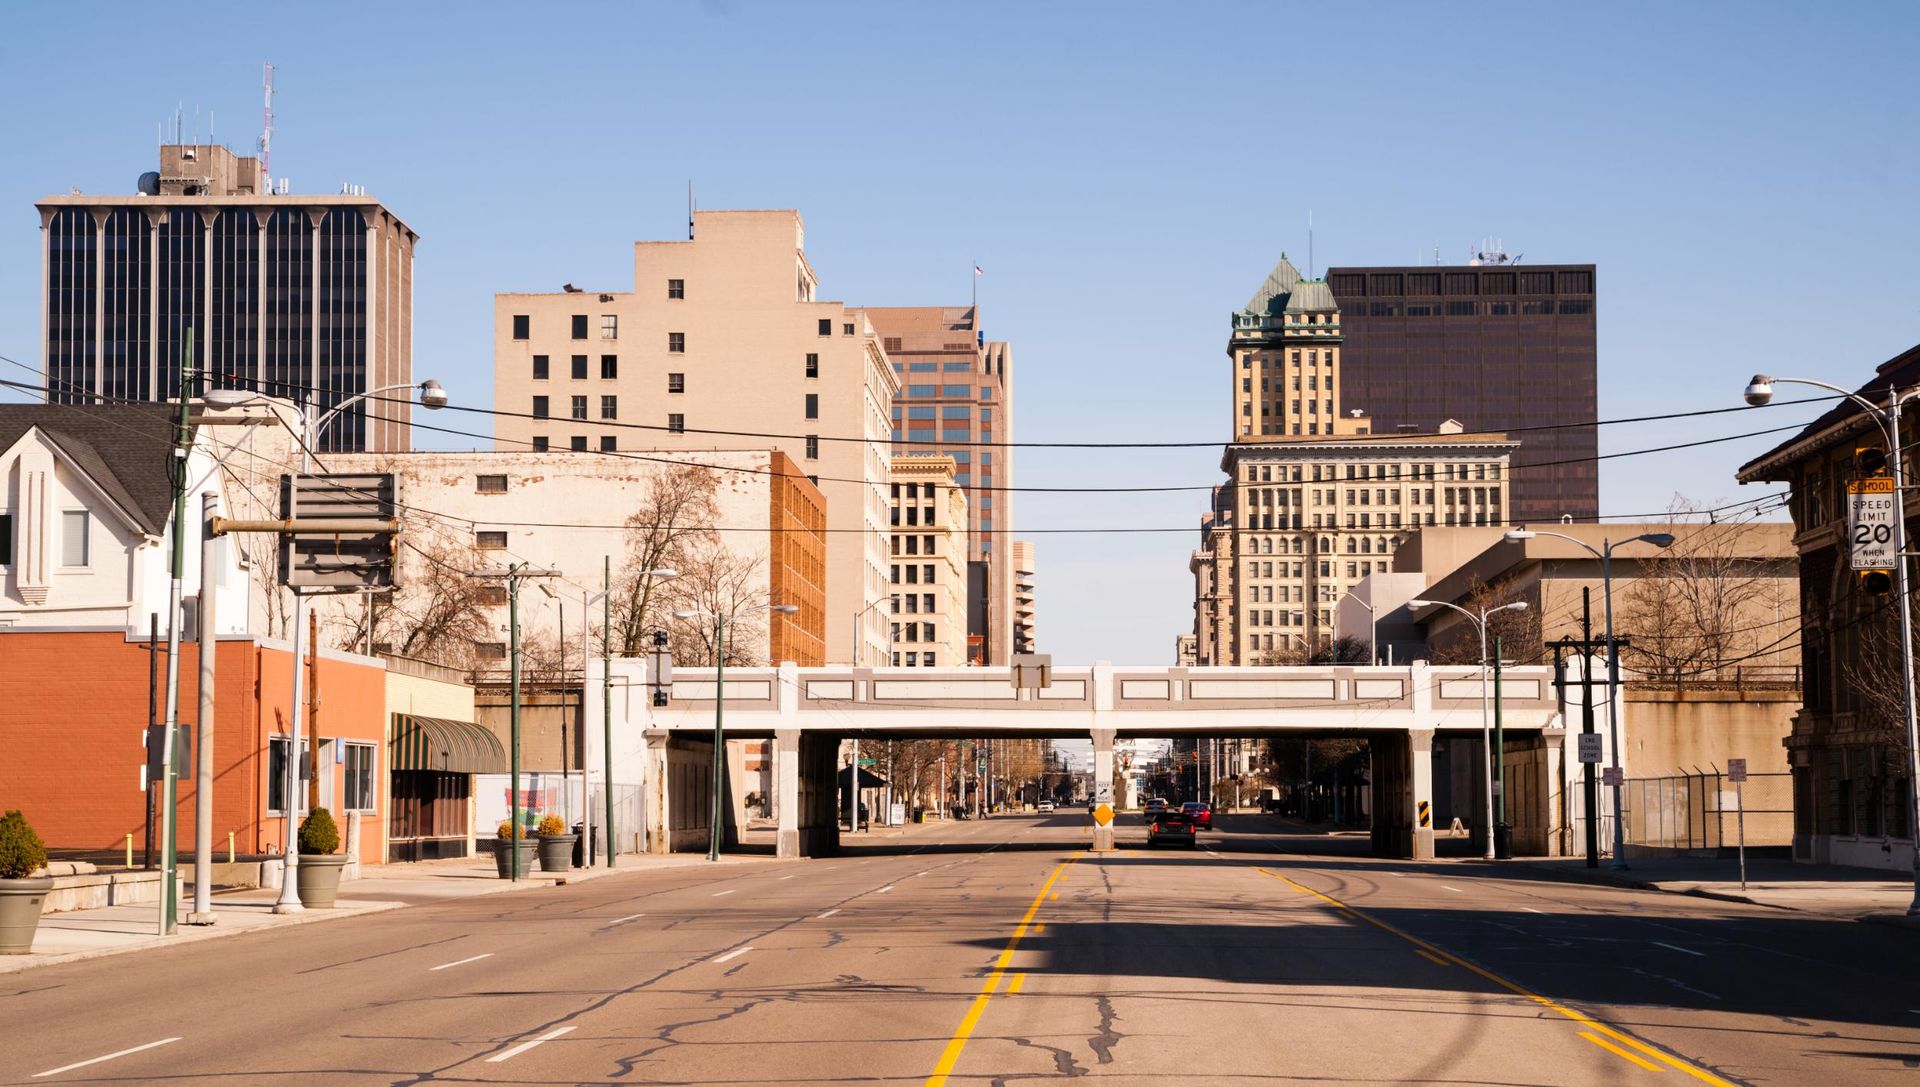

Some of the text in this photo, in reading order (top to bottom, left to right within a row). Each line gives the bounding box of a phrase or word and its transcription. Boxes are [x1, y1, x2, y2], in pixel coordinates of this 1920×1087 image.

[1851, 482, 1891, 490] SCHOOL
[1852, 500, 1891, 510] SPEED
[1857, 512, 1887, 522] LIMIT
[1854, 524, 1891, 544] 20
[1862, 549, 1885, 557] WHEN
[1854, 558, 1894, 567] FLASHING
